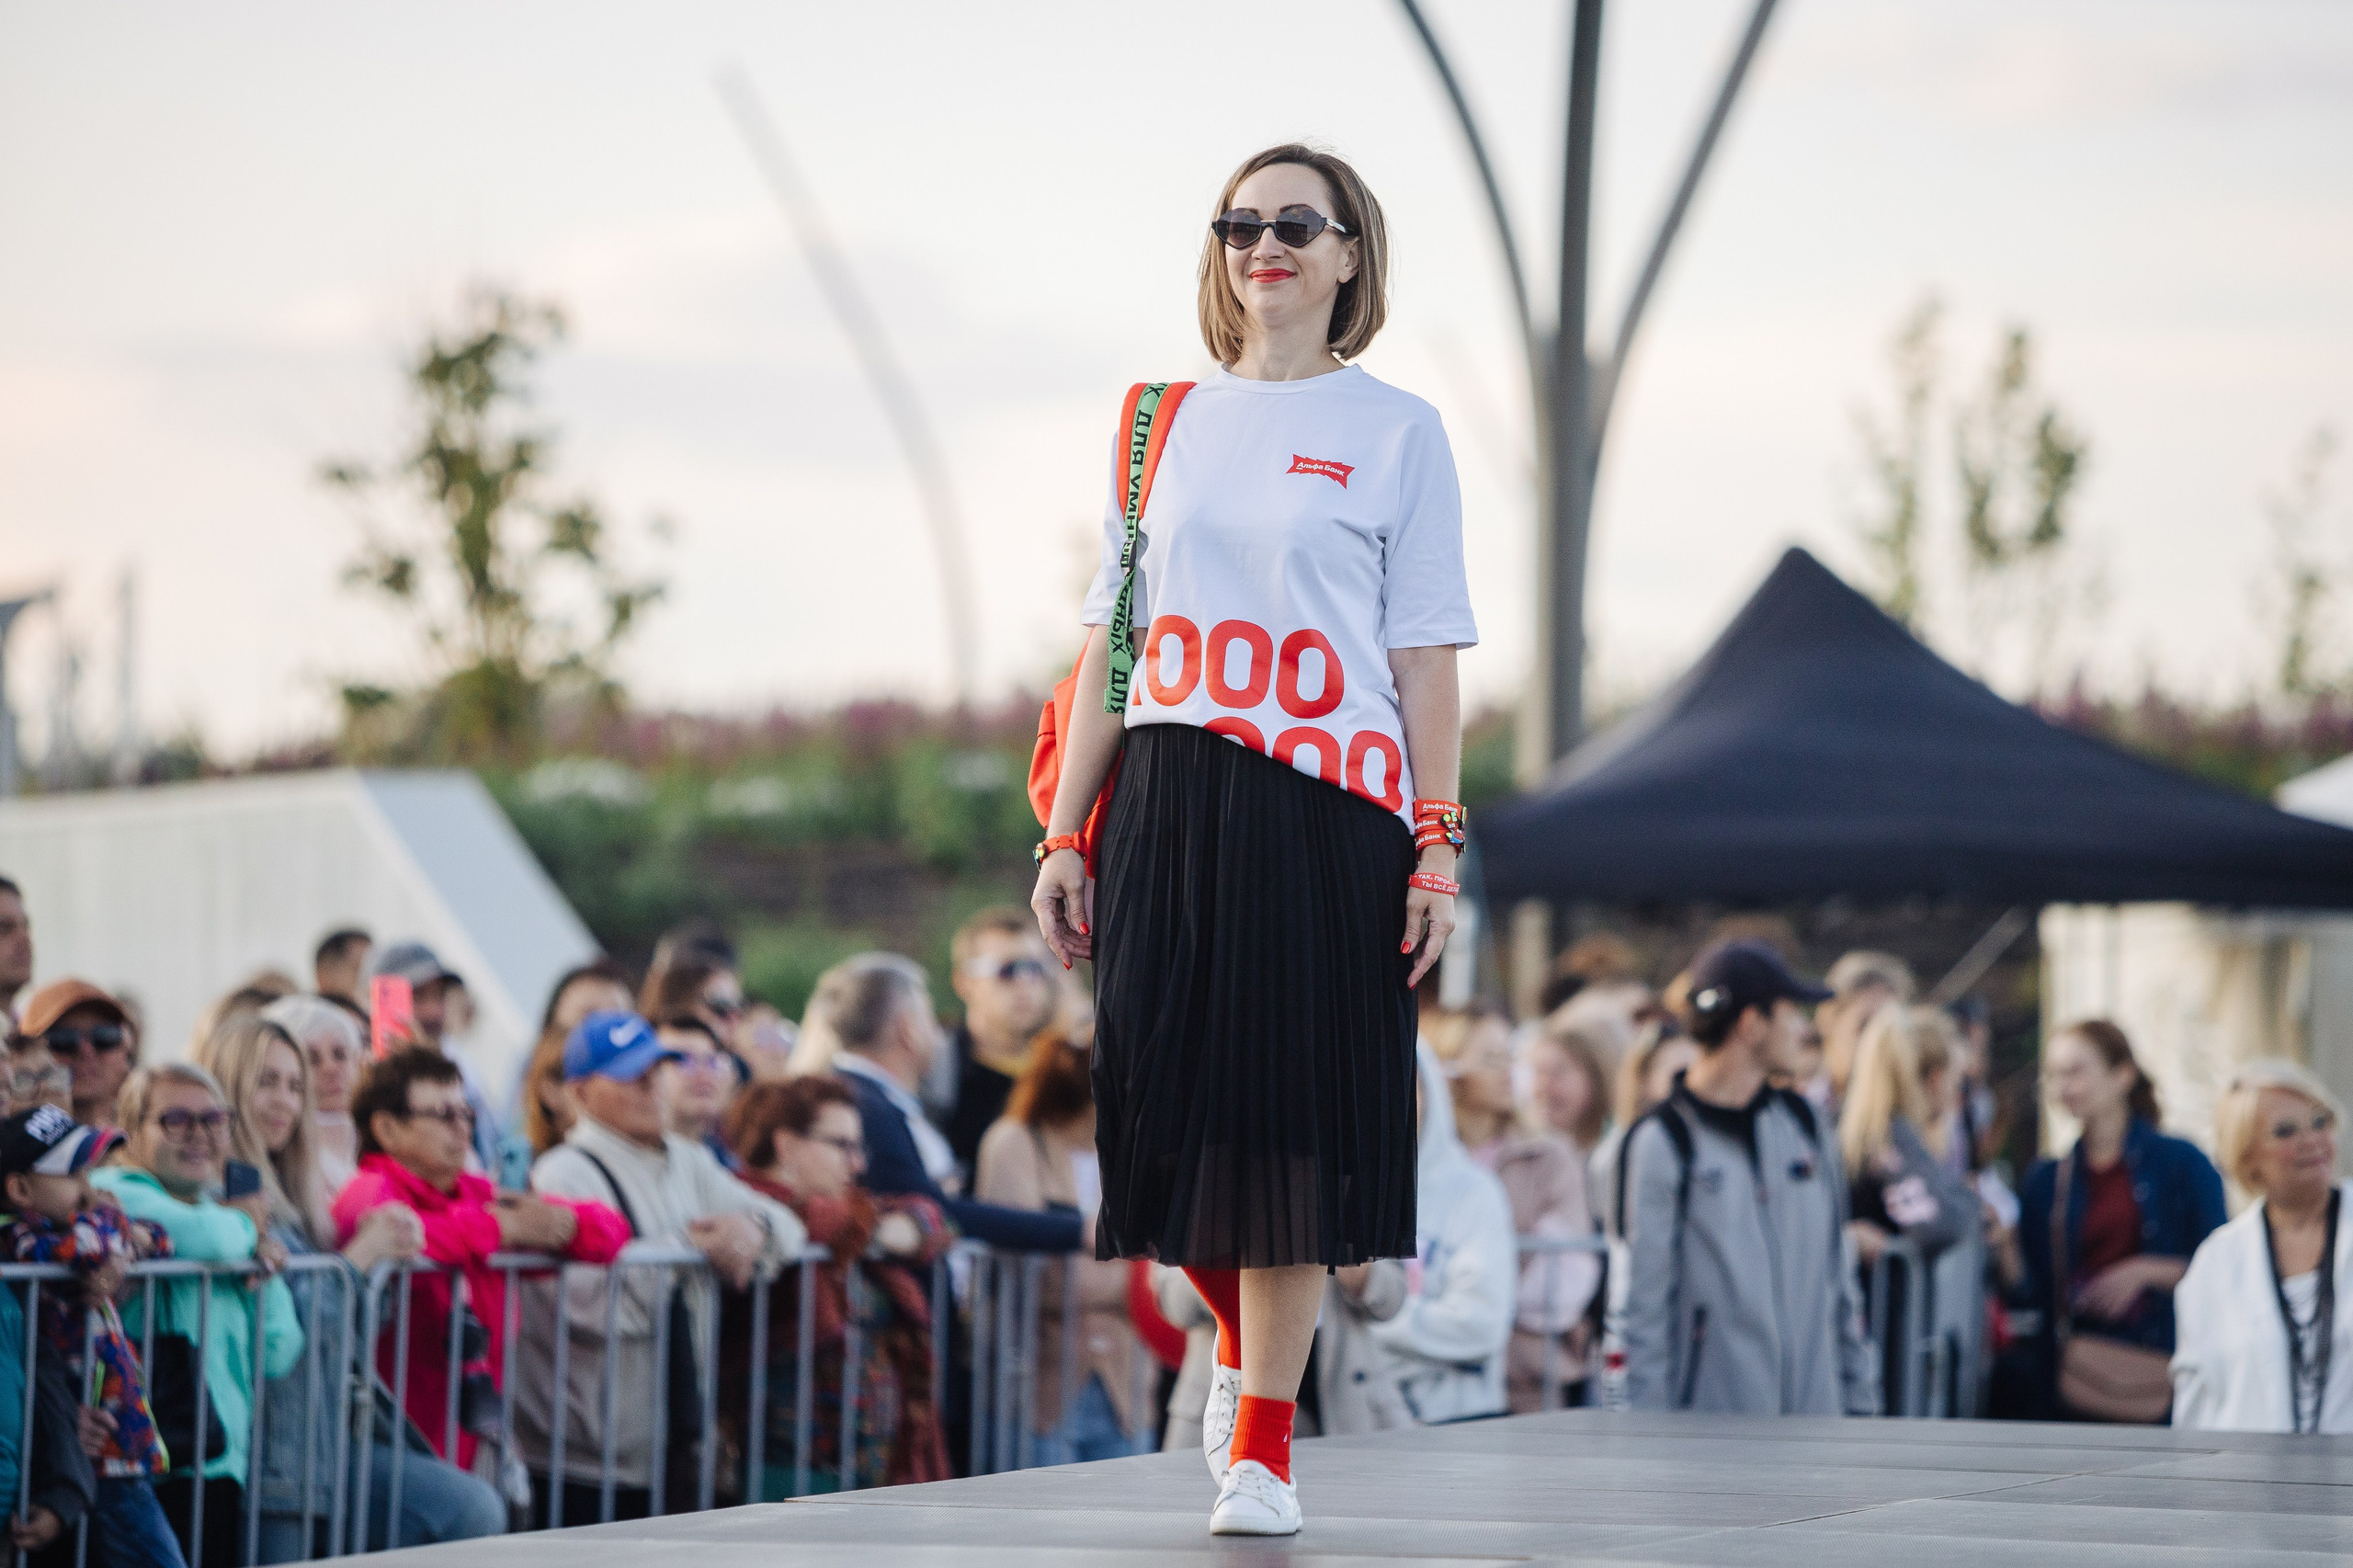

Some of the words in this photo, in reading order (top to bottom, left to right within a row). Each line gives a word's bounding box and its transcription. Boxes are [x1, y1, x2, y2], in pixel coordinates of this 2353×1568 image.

[1131, 409, 1152, 466] ДЛЯ
[1295, 461, 1324, 471] Альфа
[1324, 465, 1345, 476] Банк
[1422, 803, 1443, 812] Альфа
[1445, 804, 1458, 812] Банк
[1422, 881, 1433, 889] ТЫ
[1433, 883, 1447, 892] ВСЁ
